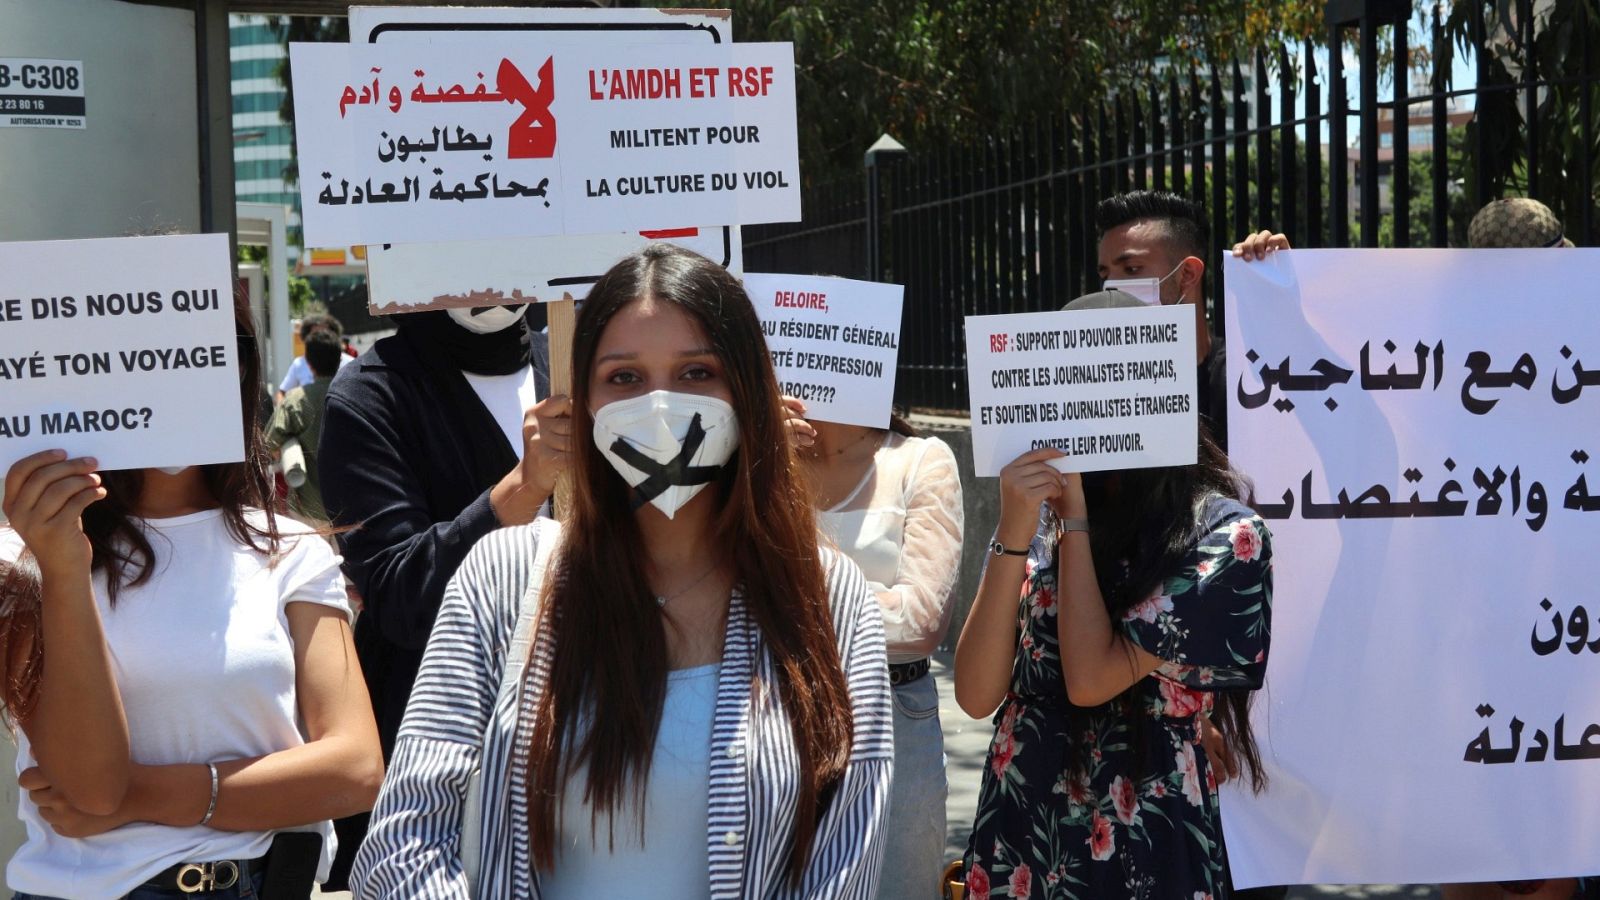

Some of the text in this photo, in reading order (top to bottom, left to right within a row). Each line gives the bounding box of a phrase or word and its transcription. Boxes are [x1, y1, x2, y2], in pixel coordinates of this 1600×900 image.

[411, 69, 514, 104] فصة
[690, 67, 719, 98] ET
[728, 66, 773, 97] RSF
[5, 100, 17, 110] 23
[19, 100, 30, 110] 80
[32, 101, 44, 110] 16
[496, 56, 556, 159] لا
[10, 118, 56, 126] AUTORISATION
[611, 125, 760, 148] MILITENT POUR
[378, 125, 493, 163] يطالبون
[318, 167, 550, 208] بمحاكمة العادلة
[586, 170, 788, 197] LA CULTURE DU VIOL
[0, 288, 219, 322] E DIS NOUS QUI
[774, 291, 829, 314] DELOIRE,
[779, 318, 839, 342] RÉSIDENT
[842, 324, 897, 349] GÉNÉRAL
[990, 333, 1008, 352] RSF
[1016, 330, 1060, 351] SUPPORT
[1063, 329, 1077, 349] DU
[1080, 326, 1122, 347] POUVOIR
[1124, 325, 1138, 345] EN
[1140, 323, 1178, 344] FRANCE
[0, 346, 226, 380] AYÉ TON VOYAGE
[991, 359, 1177, 389] CONTRE LES JOURNALISTES FRANÇAIS,
[1237, 339, 1444, 412] الناجين
[1461, 351, 1537, 415] مع
[0, 407, 153, 438] AU MAROC?
[981, 393, 1190, 425] ET SOUTIEN DES JOURNALISTES ÉTRANGERS
[1072, 436, 1097, 456] LEUR
[1099, 433, 1144, 454] POUVOIR.
